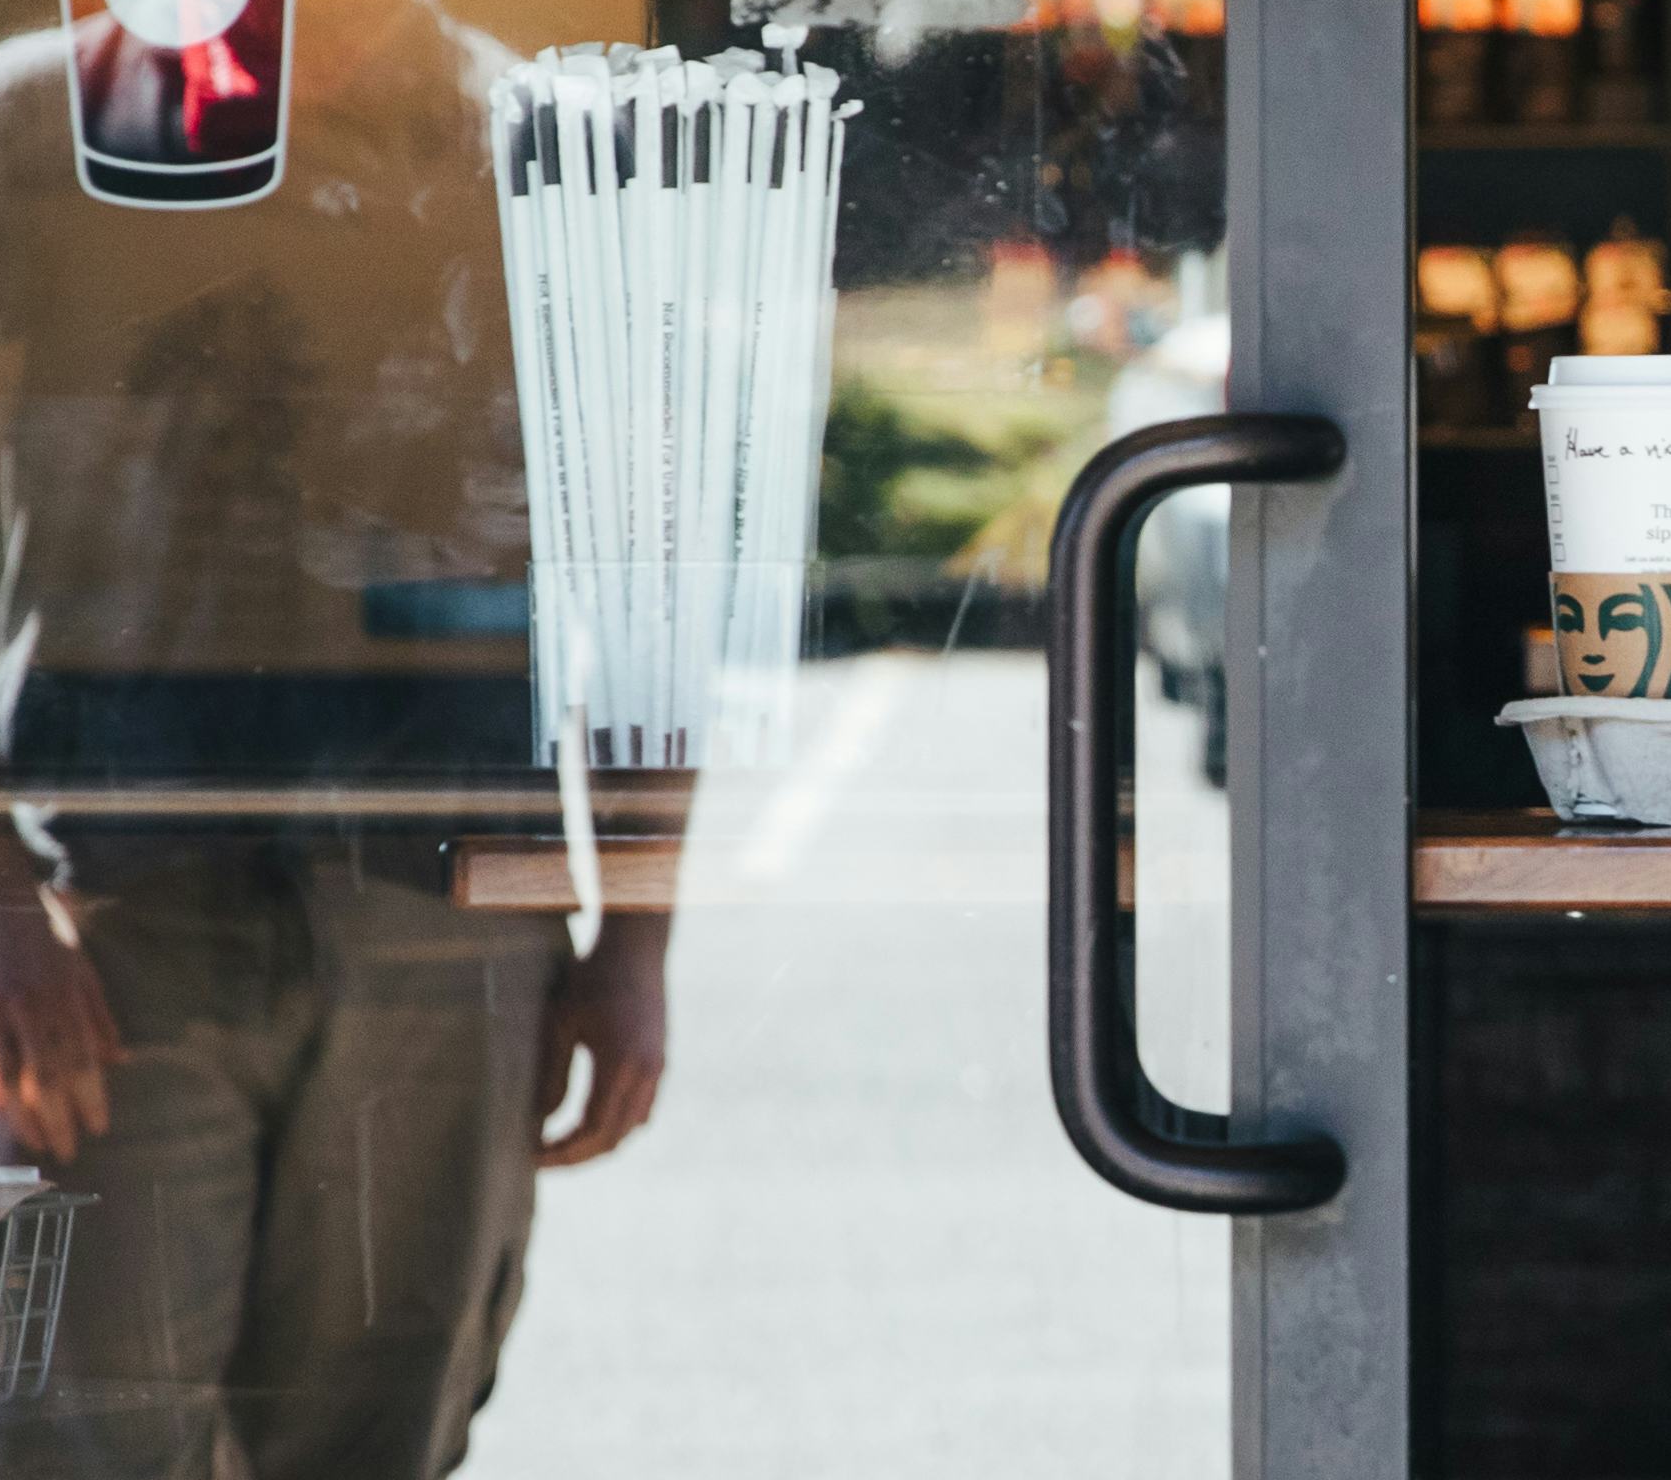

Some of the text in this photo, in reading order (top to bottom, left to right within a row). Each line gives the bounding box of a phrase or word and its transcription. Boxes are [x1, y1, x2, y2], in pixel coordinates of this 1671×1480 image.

[662, 302, 675, 327] Not
[662, 331, 676, 438] Recommended
[1565, 426, 1610, 461] Have
[1620, 446, 1633, 456] a
[662, 519, 675, 544] Hot
[1646, 526, 1671, 543] sip
